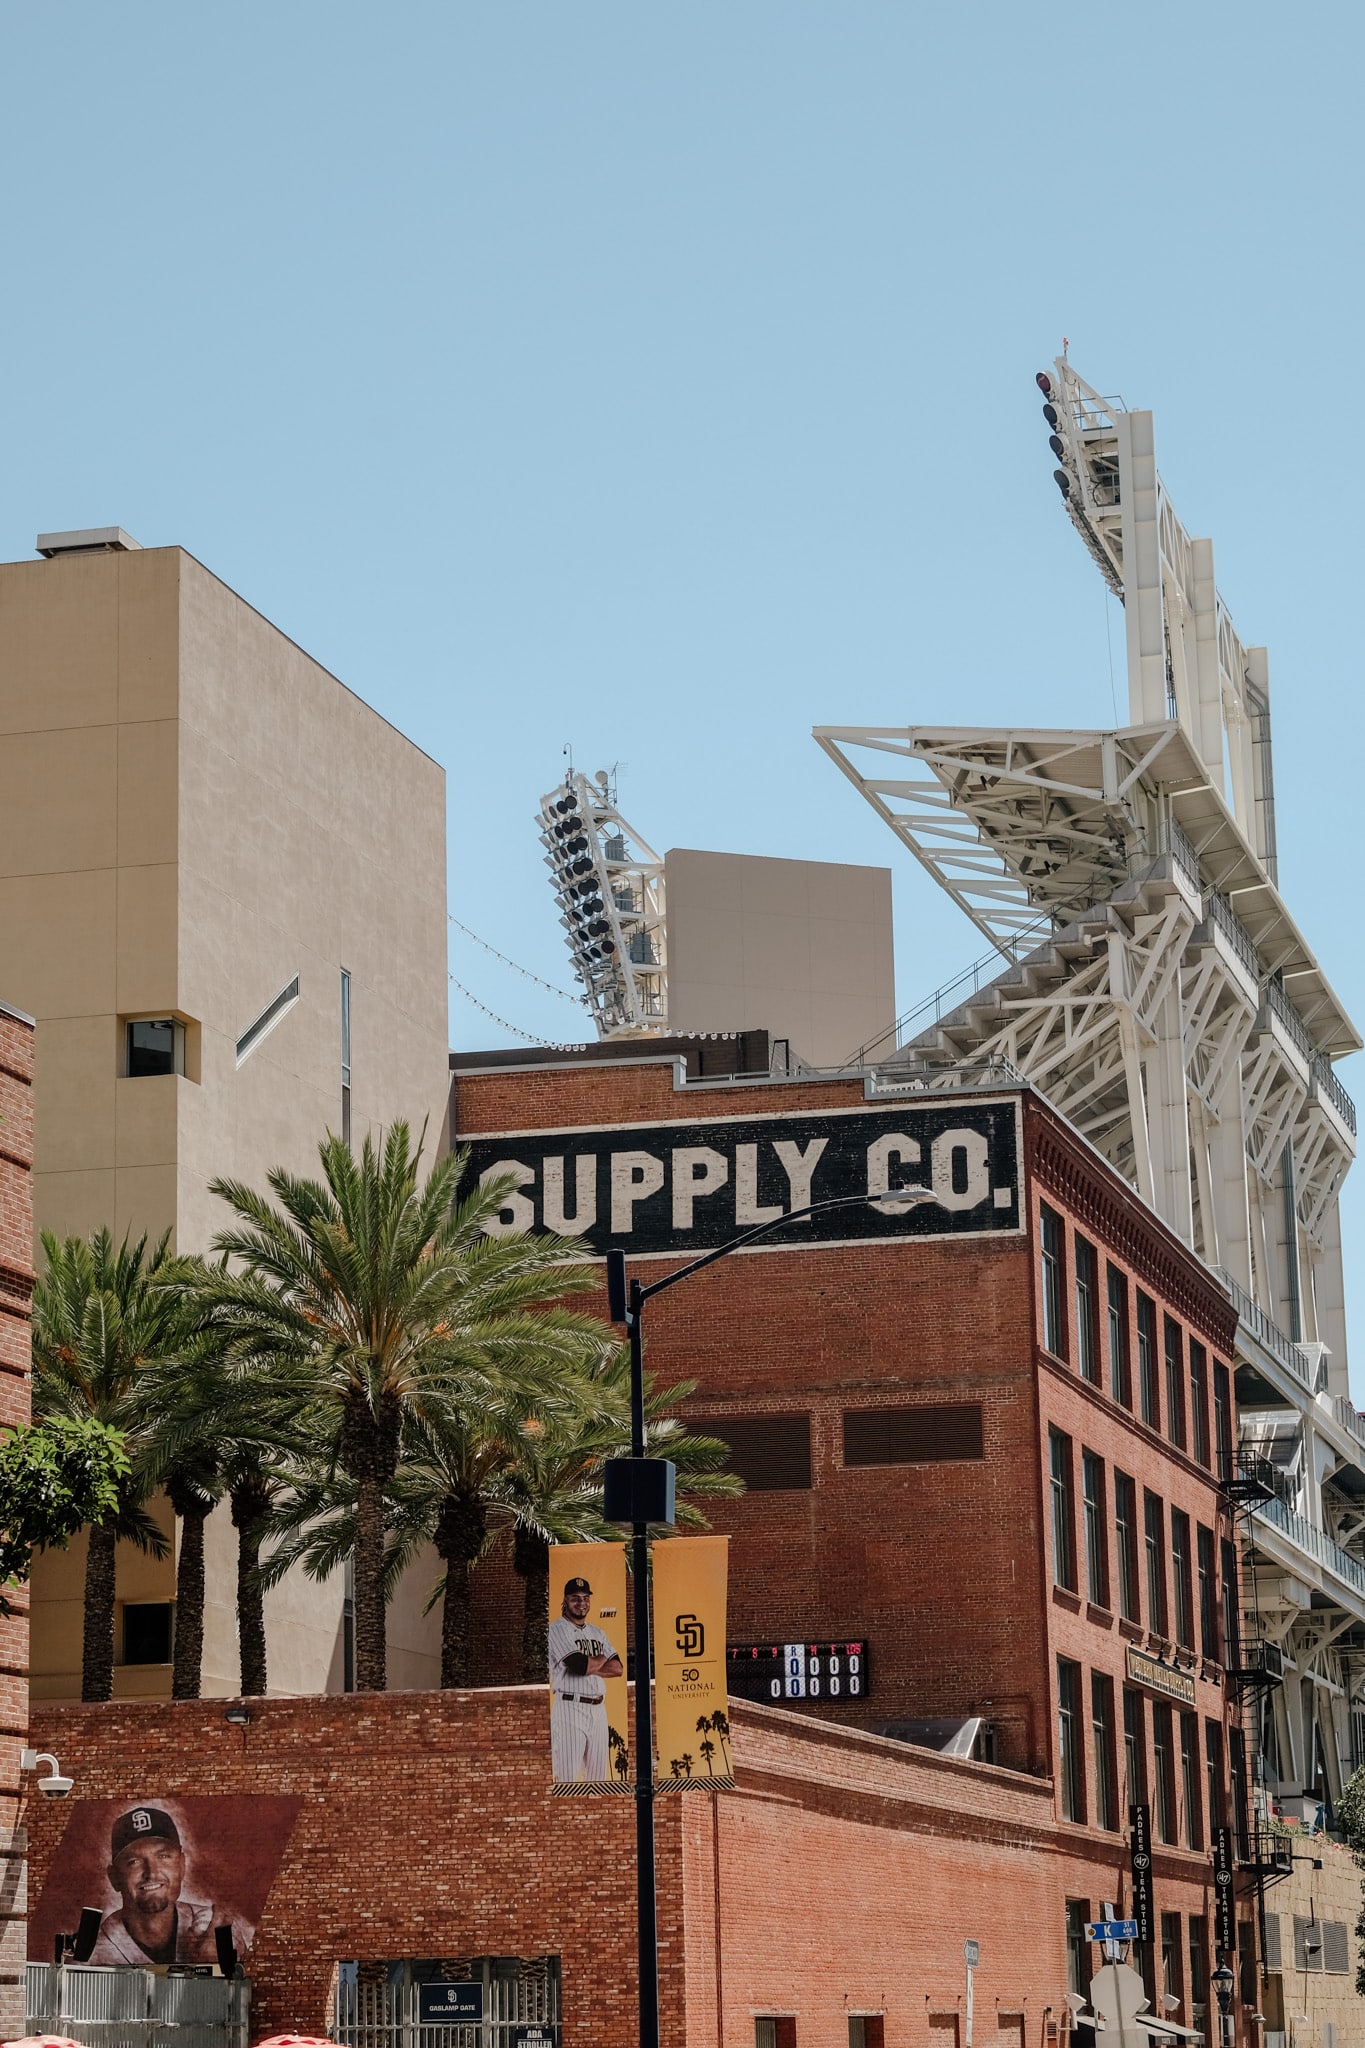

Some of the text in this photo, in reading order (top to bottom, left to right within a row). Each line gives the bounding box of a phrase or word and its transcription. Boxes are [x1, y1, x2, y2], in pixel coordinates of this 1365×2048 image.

[479, 1128, 1012, 1238] SUPPLY CO.
[676, 1614, 704, 1657] SD
[732, 1648, 739, 1659] 7
[752, 1647, 758, 1659] 8
[772, 1647, 778, 1658] 9
[791, 1646, 797, 1656] R
[791, 1655, 860, 1676] 0 0 0 0
[682, 1668, 700, 1682] 50
[667, 1682, 716, 1693] NATIONAL
[770, 1675, 860, 1698] 0 0 0 0 0
[1103, 1925, 1112, 1936] K
[526, 2030, 543, 2039] ADA
[517, 2040, 553, 2048] STROLLER
